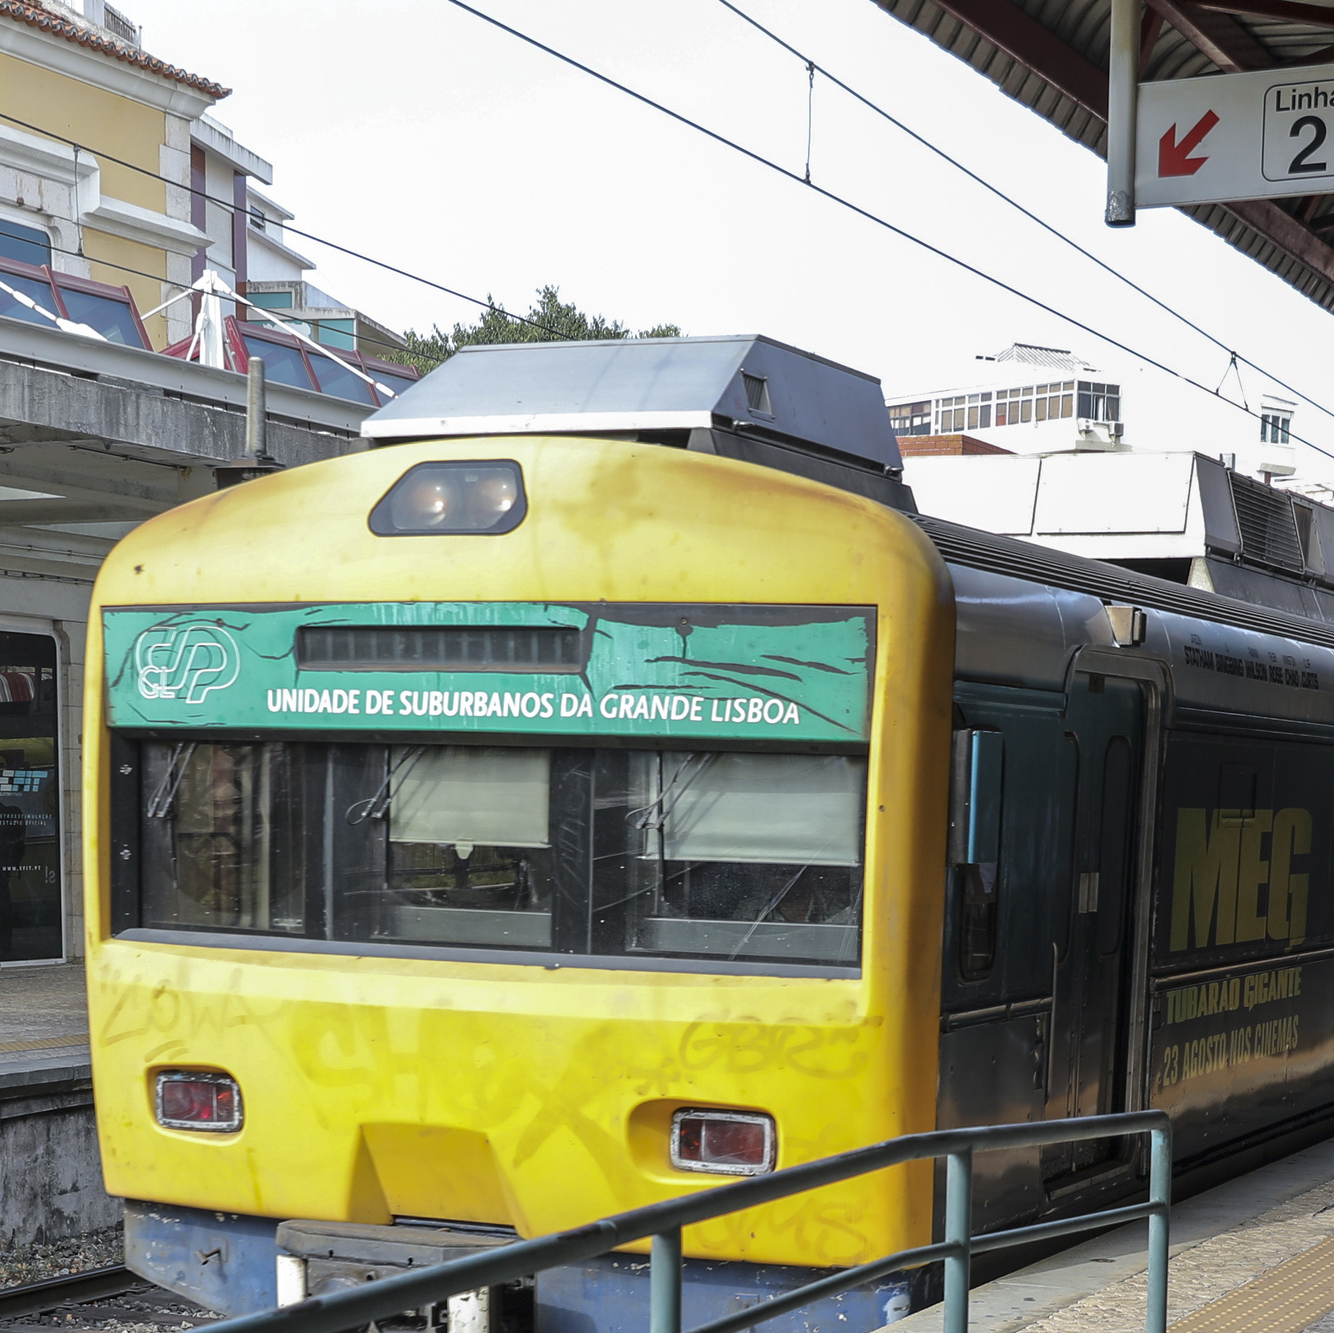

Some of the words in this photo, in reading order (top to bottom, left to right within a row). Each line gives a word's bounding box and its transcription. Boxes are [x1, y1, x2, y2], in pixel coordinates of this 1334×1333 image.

[1288, 115, 1327, 174] 2
[1183, 645, 1215, 671] STATHAM
[1244, 659, 1268, 682] WILSON
[1268, 665, 1284, 685] ROSE
[267, 688, 361, 714] UNIDADE
[365, 689, 395, 715] DE
[398, 690, 555, 719] SUBURBANOS
[559, 692, 595, 719] DA
[598, 693, 703, 722] GRANDE
[710, 696, 801, 725] LISBOA
[1170, 807, 1313, 953] MEG
[1166, 973, 1240, 1025] TUBARÃO
[1243, 966, 1303, 1011] GIGANTE
[1163, 1045, 1179, 1087] 23
[1181, 1032, 1227, 1081] AGOSTO
[1229, 1022, 1252, 1067] NOS
[1253, 1014, 1300, 1061] CINEMAS
